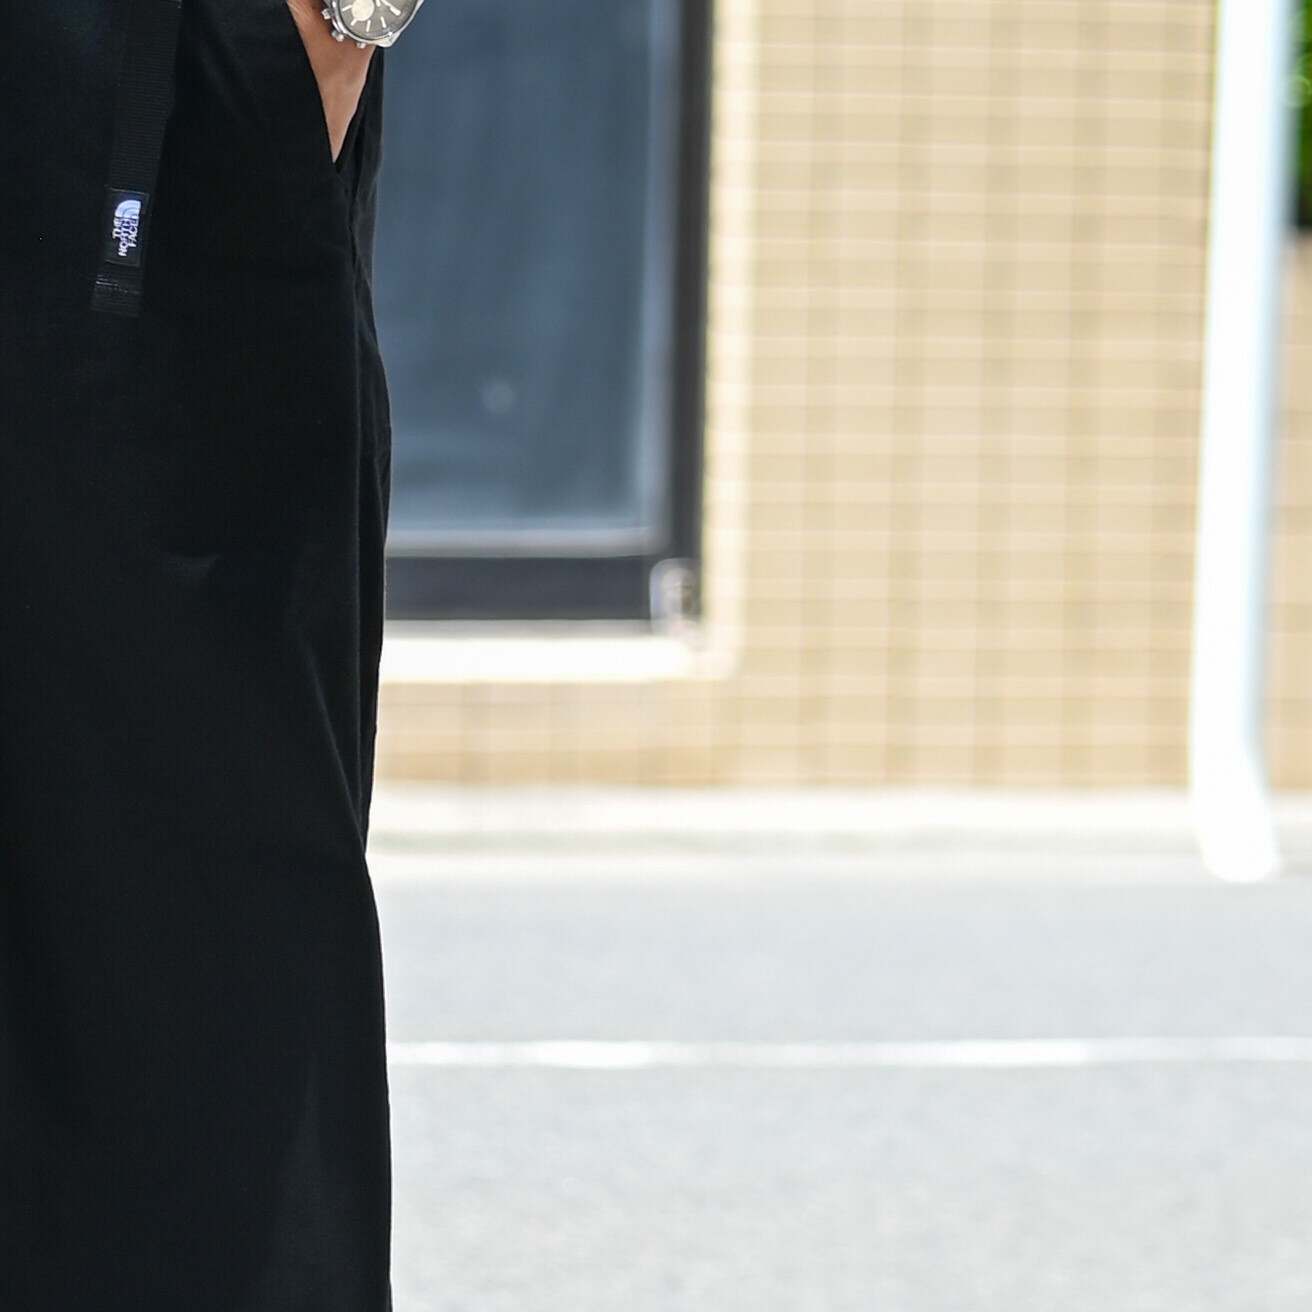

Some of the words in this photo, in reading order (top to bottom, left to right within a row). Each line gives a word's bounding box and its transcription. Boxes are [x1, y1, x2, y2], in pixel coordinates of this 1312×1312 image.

[112, 217, 121, 239] THE
[118, 218, 130, 256] NORTH
[128, 218, 138, 247] FACE
